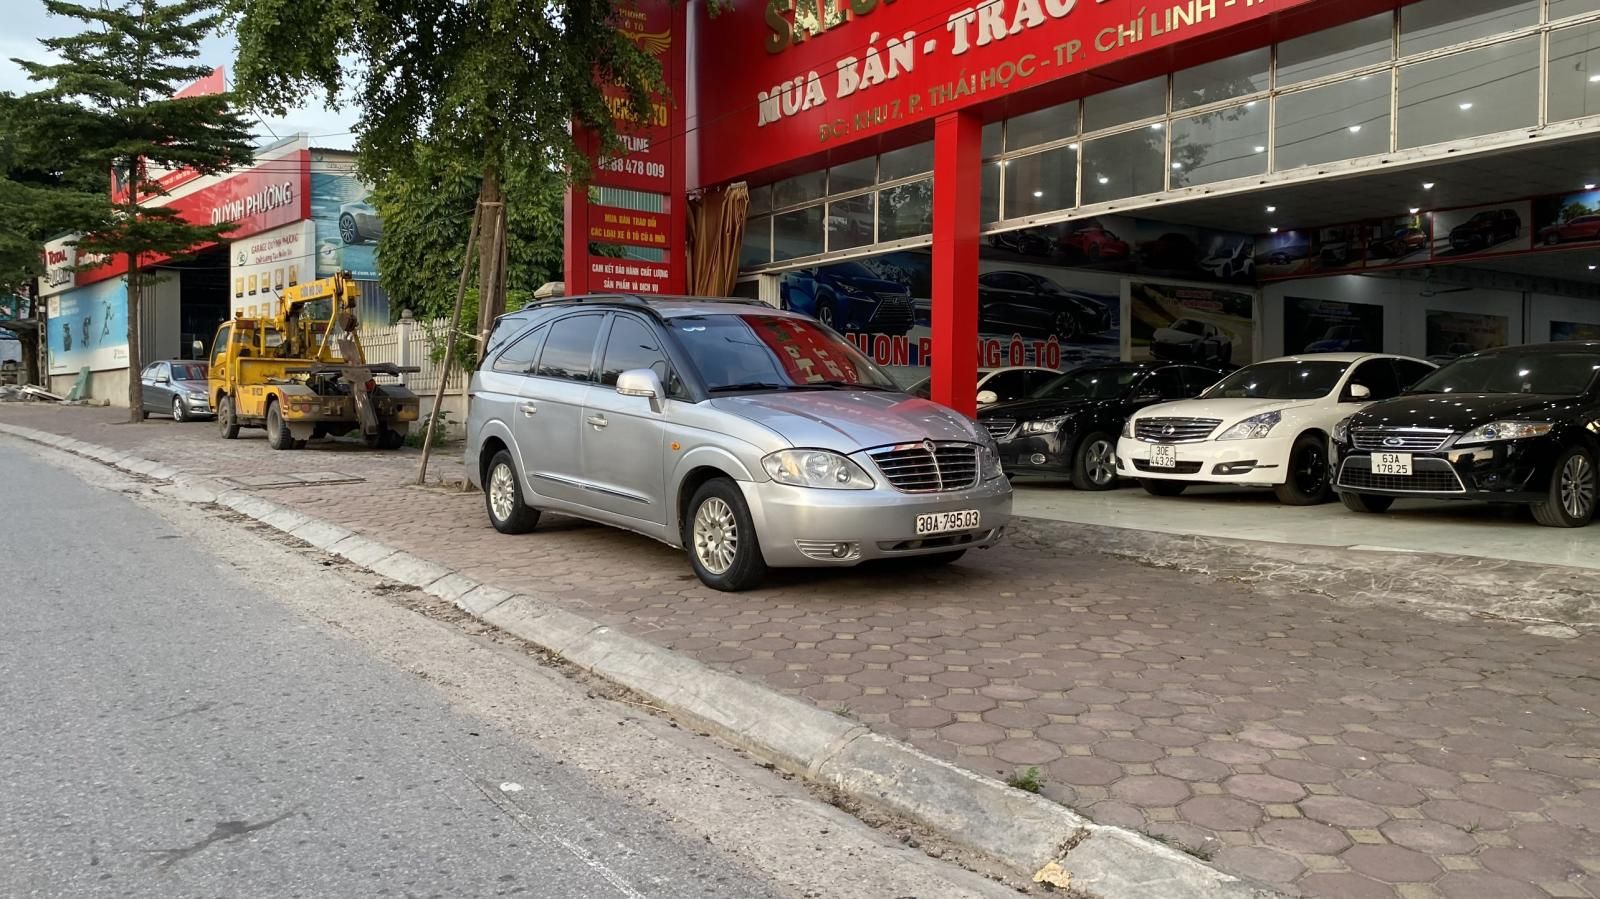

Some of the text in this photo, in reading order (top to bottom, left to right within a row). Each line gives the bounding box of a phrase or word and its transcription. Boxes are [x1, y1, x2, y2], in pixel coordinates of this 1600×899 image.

[819, 119, 849, 142] ĐC:
[853, 103, 889, 131] KHU
[908, 93, 924, 114] P.
[928, 68, 977, 107] THÁI
[980, 54, 1037, 91] HỌC
[1053, 39, 1087, 68] TP.
[1095, 6, 1147, 52] CHÍ
[1151, 0, 1217, 37] LINH
[758, 70, 828, 127] MUA
[836, 31, 916, 98] BÁN
[625, 159, 644, 175] 478
[646, 162, 665, 178] 009
[617, 230, 625, 240] XE
[591, 263, 604, 273] CAM
[1009, 332, 1025, 367] Ô
[1032, 334, 1061, 368] TÔ
[1156, 446, 1169, 456] 30E
[1382, 454, 1400, 463] 63A
[1376, 464, 1408, 474] 178.25
[918, 511, 979, 533] 30A-795.03
